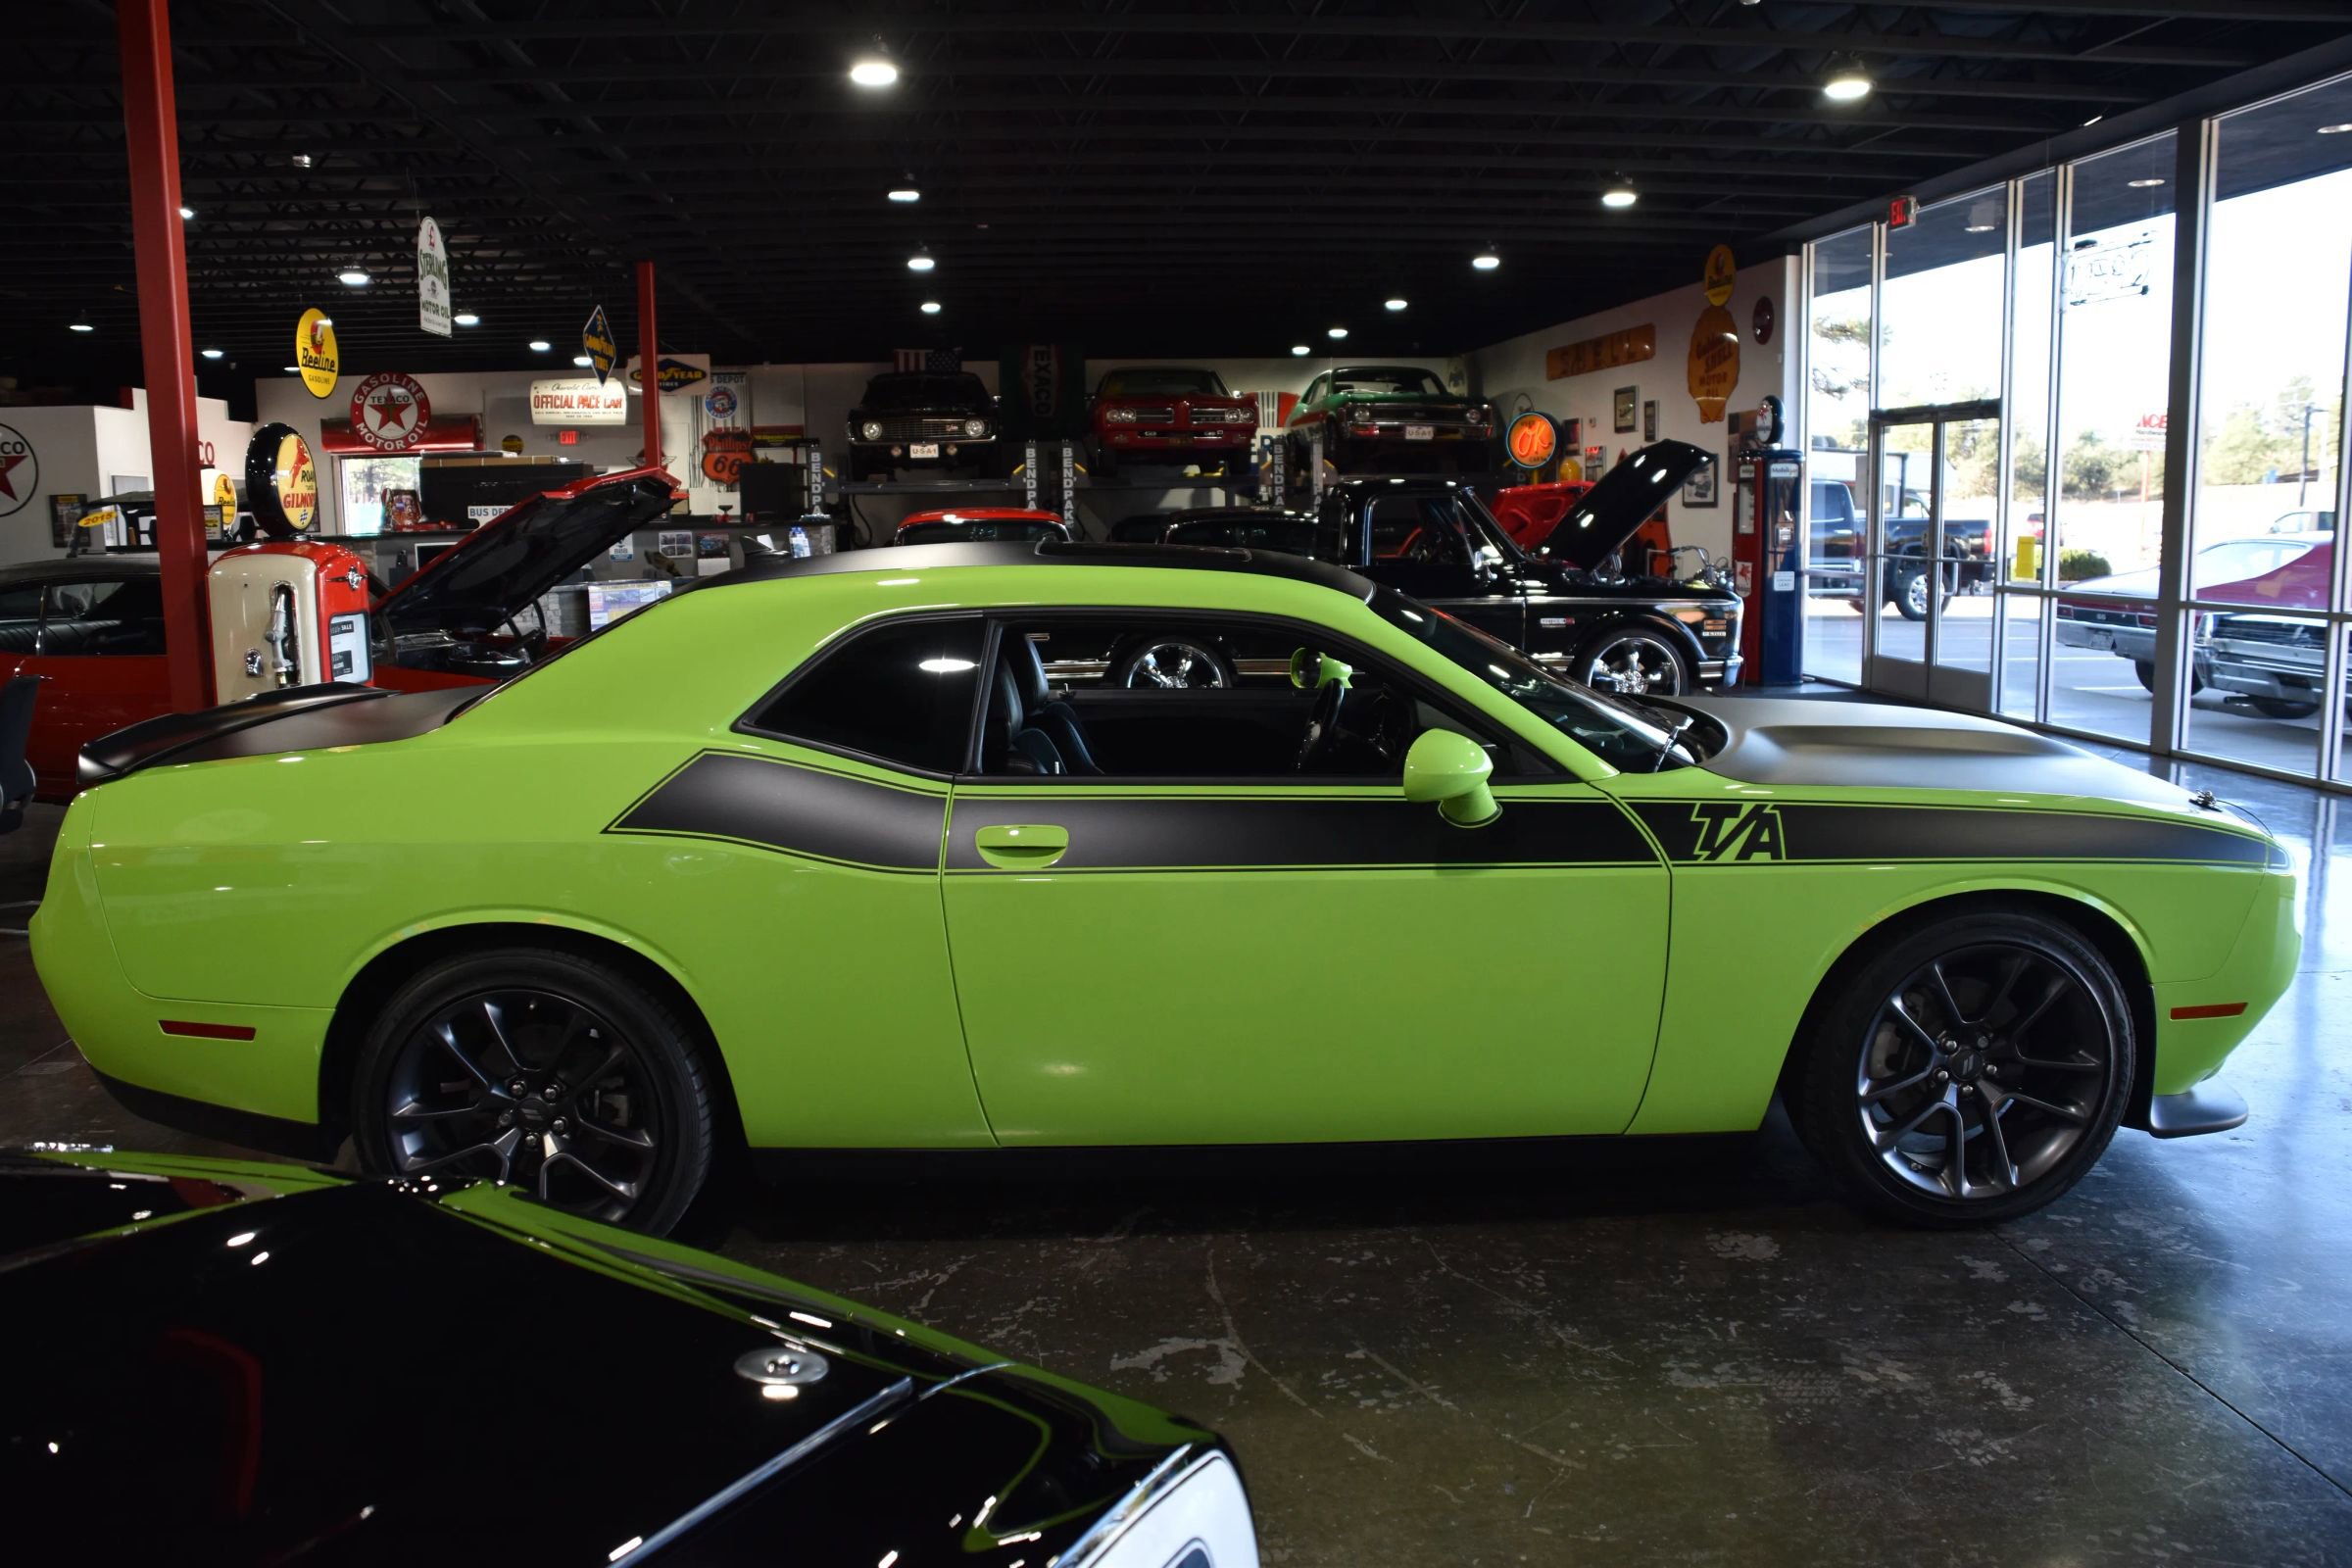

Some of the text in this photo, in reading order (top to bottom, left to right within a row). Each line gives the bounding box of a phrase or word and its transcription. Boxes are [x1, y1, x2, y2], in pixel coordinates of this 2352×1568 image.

[419, 249, 447, 290] STERLING
[420, 298, 451, 319] MOTOR OIL
[301, 347, 336, 373] Beeline
[309, 374, 330, 385] GASOLINE
[354, 373, 424, 404] GASOLINE
[533, 394, 575, 409] OFFICIAL
[577, 394, 601, 409] PACE
[356, 419, 428, 451] MOTOR OIL
[560, 430, 576, 445] EXIT
[1518, 420, 1552, 457] OK
[301, 470, 314, 482] ROA
[713, 455, 741, 476] 66
[1274, 444, 1285, 506] BENDPA
[810, 452, 821, 514] BENDPA
[1025, 448, 1037, 511] BENDPA
[82, 512, 113, 525] 2015
[469, 508, 509, 516] BUS DEP
